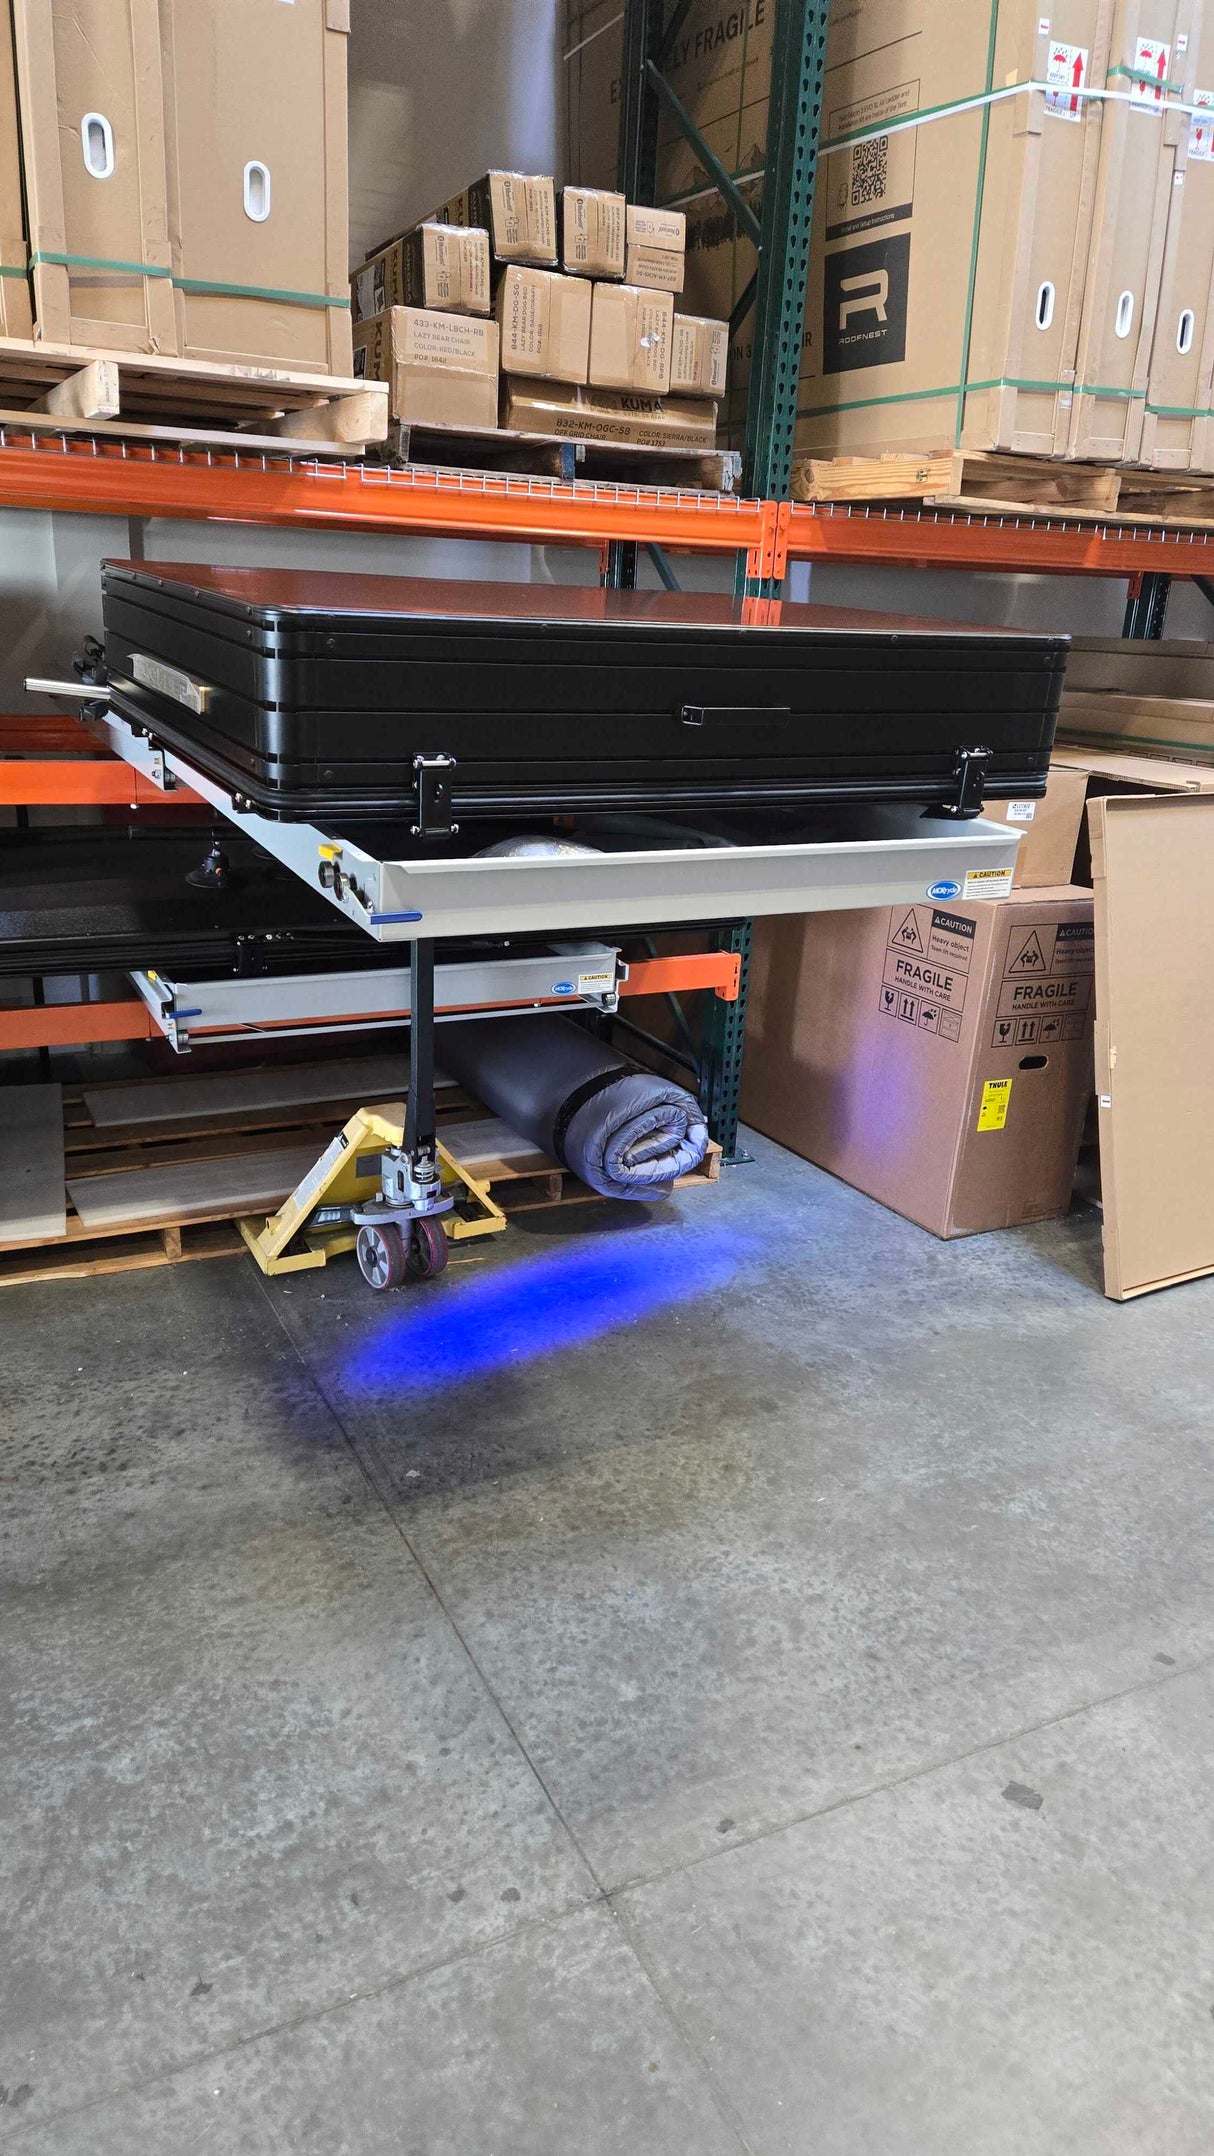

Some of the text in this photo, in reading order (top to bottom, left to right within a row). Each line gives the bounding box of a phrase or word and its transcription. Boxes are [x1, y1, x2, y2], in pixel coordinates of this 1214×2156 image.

[694, 0, 765, 58] FRAGIE
[413, 319, 484, 337] 433-KM-LBCH-RB
[414, 331, 431, 339] LAZY
[802, 331, 812, 348] IR
[838, 329, 888, 345] ROOFNEST
[373, 322, 383, 380] KUM
[621, 397, 664, 412] KUMA
[554, 428, 568, 436] OFF
[568, 430, 585, 438] GRID
[556, 418, 631, 435] 832-KM-OGC-SB
[979, 870, 1006, 878] CAUTION
[940, 917, 973, 934] CAUTION
[1066, 927, 1094, 936] CAUTIO
[931, 945, 942, 953] Team
[932, 935, 969, 952] Heavy object
[1075, 946, 1094, 954] objec
[896, 959, 954, 991] FRAGILE
[895, 976, 952, 1001] HANDLE WITH CARE
[1013, 982, 1078, 1000] FRAGILE
[1012, 1002, 1038, 1010] HANDLE
[1040, 1000, 1057, 1008] WITH
[989, 1081, 1008, 1089] THULE
